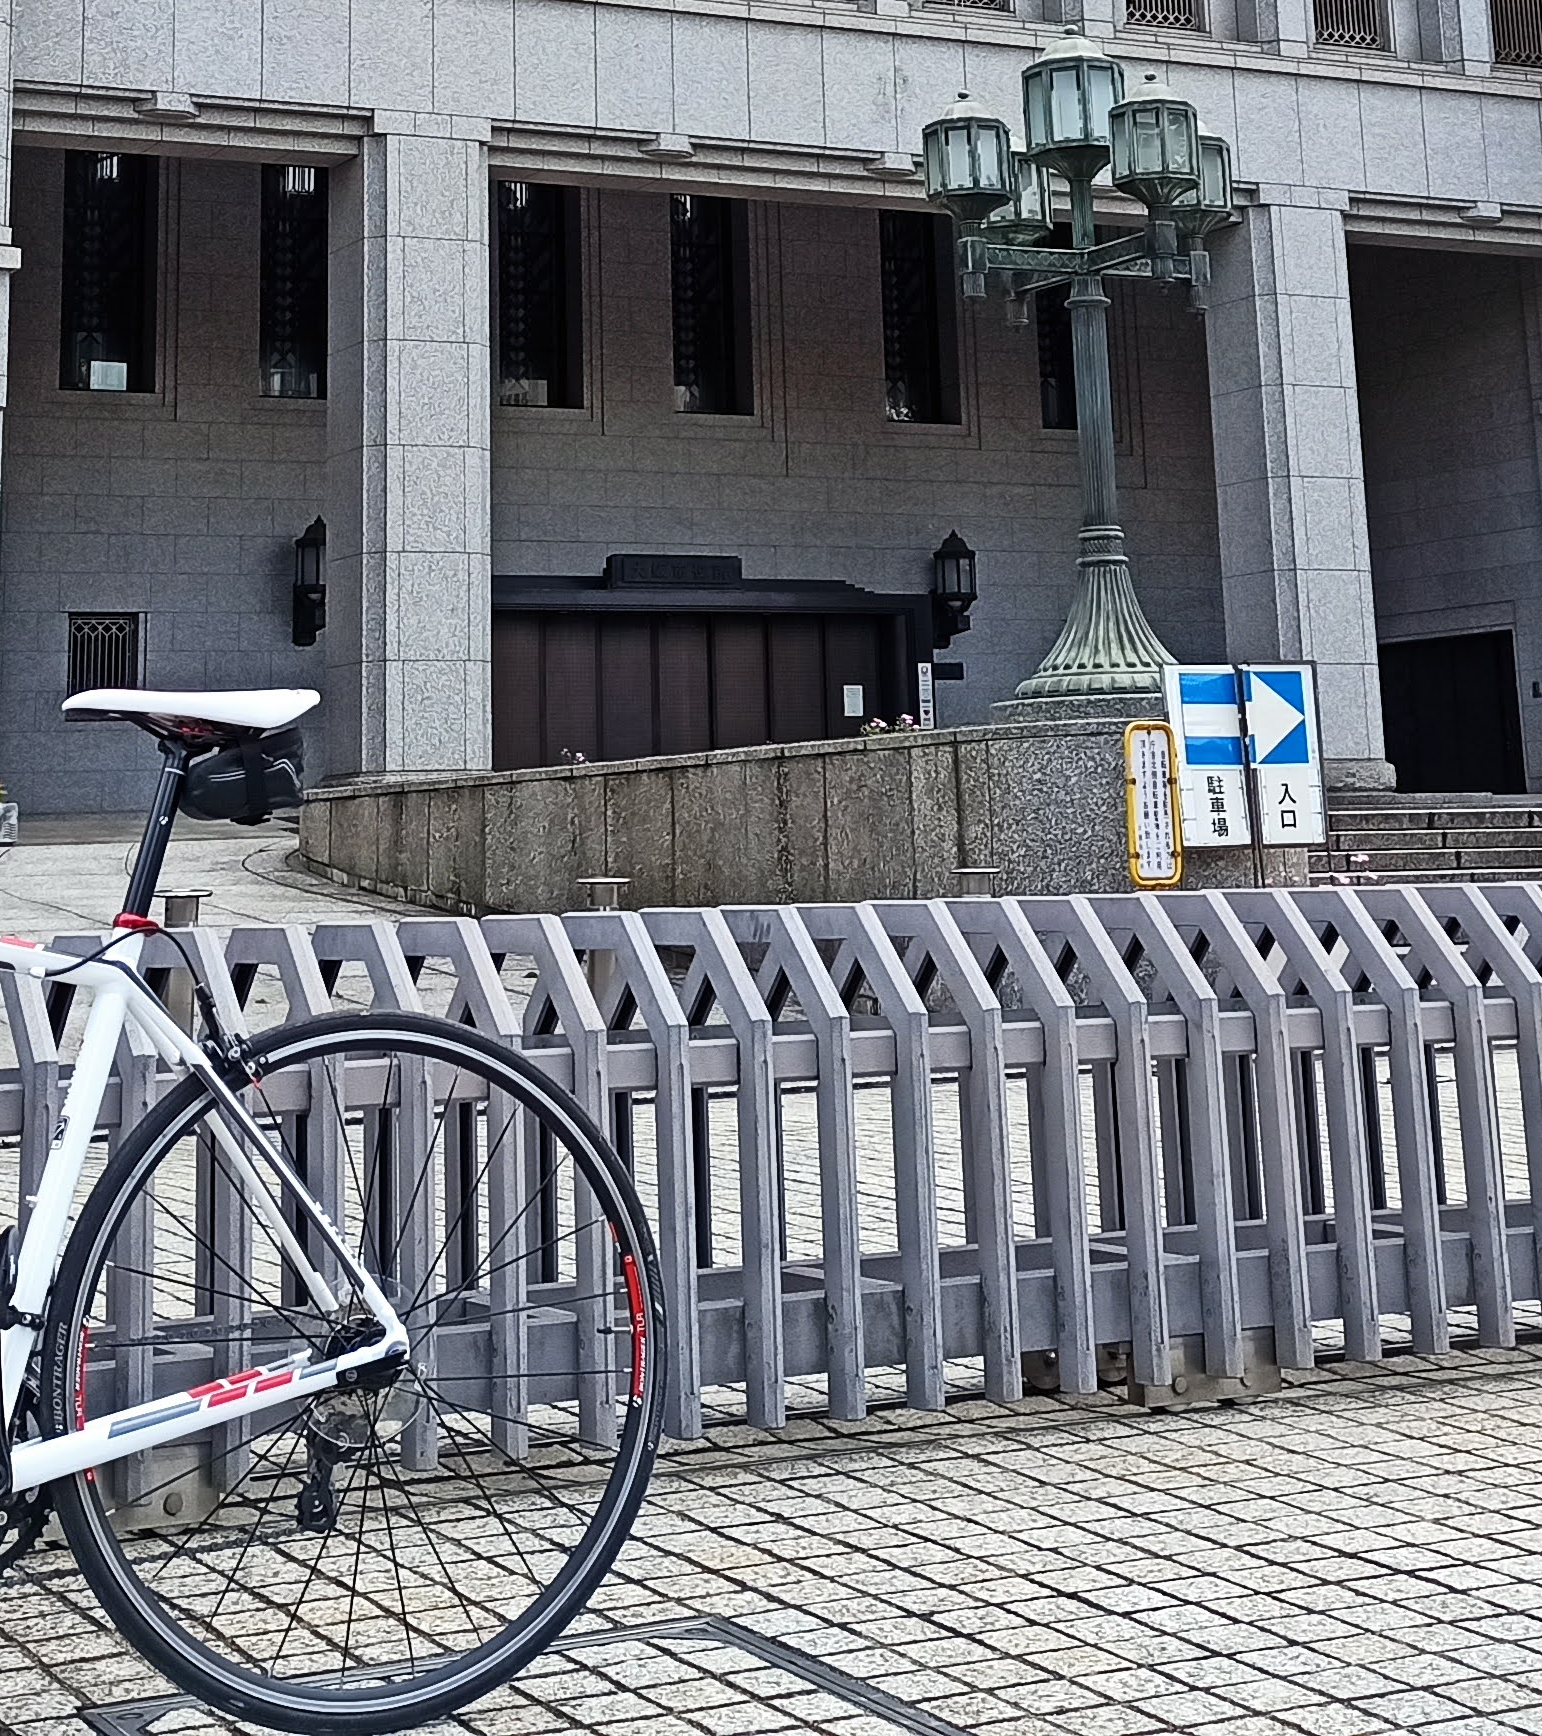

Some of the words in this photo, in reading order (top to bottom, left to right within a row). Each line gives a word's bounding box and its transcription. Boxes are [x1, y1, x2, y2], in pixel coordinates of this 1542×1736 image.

[1206, 775, 1229, 837] 駐車場
[1278, 783, 1297, 829] 入口
[53, 1322, 68, 1426] BONTRAGER
